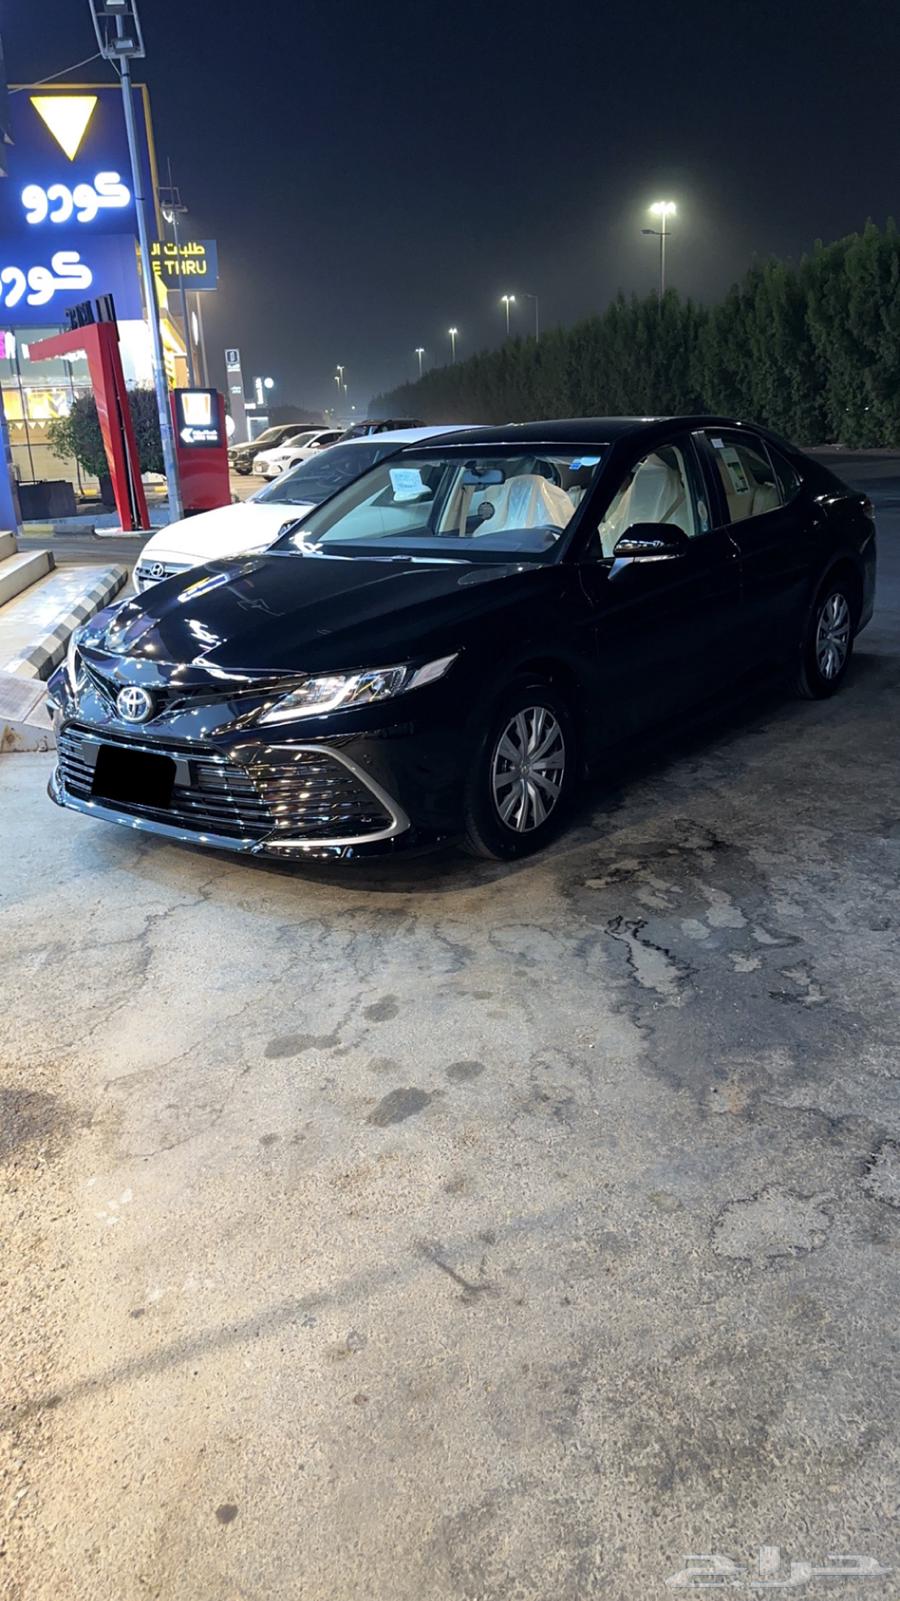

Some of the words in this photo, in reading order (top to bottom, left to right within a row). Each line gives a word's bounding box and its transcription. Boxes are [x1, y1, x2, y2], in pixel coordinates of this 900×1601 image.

[22, 172, 131, 224] كودو
[0, 251, 93, 308] كود
[164, 260, 207, 275] THRU
